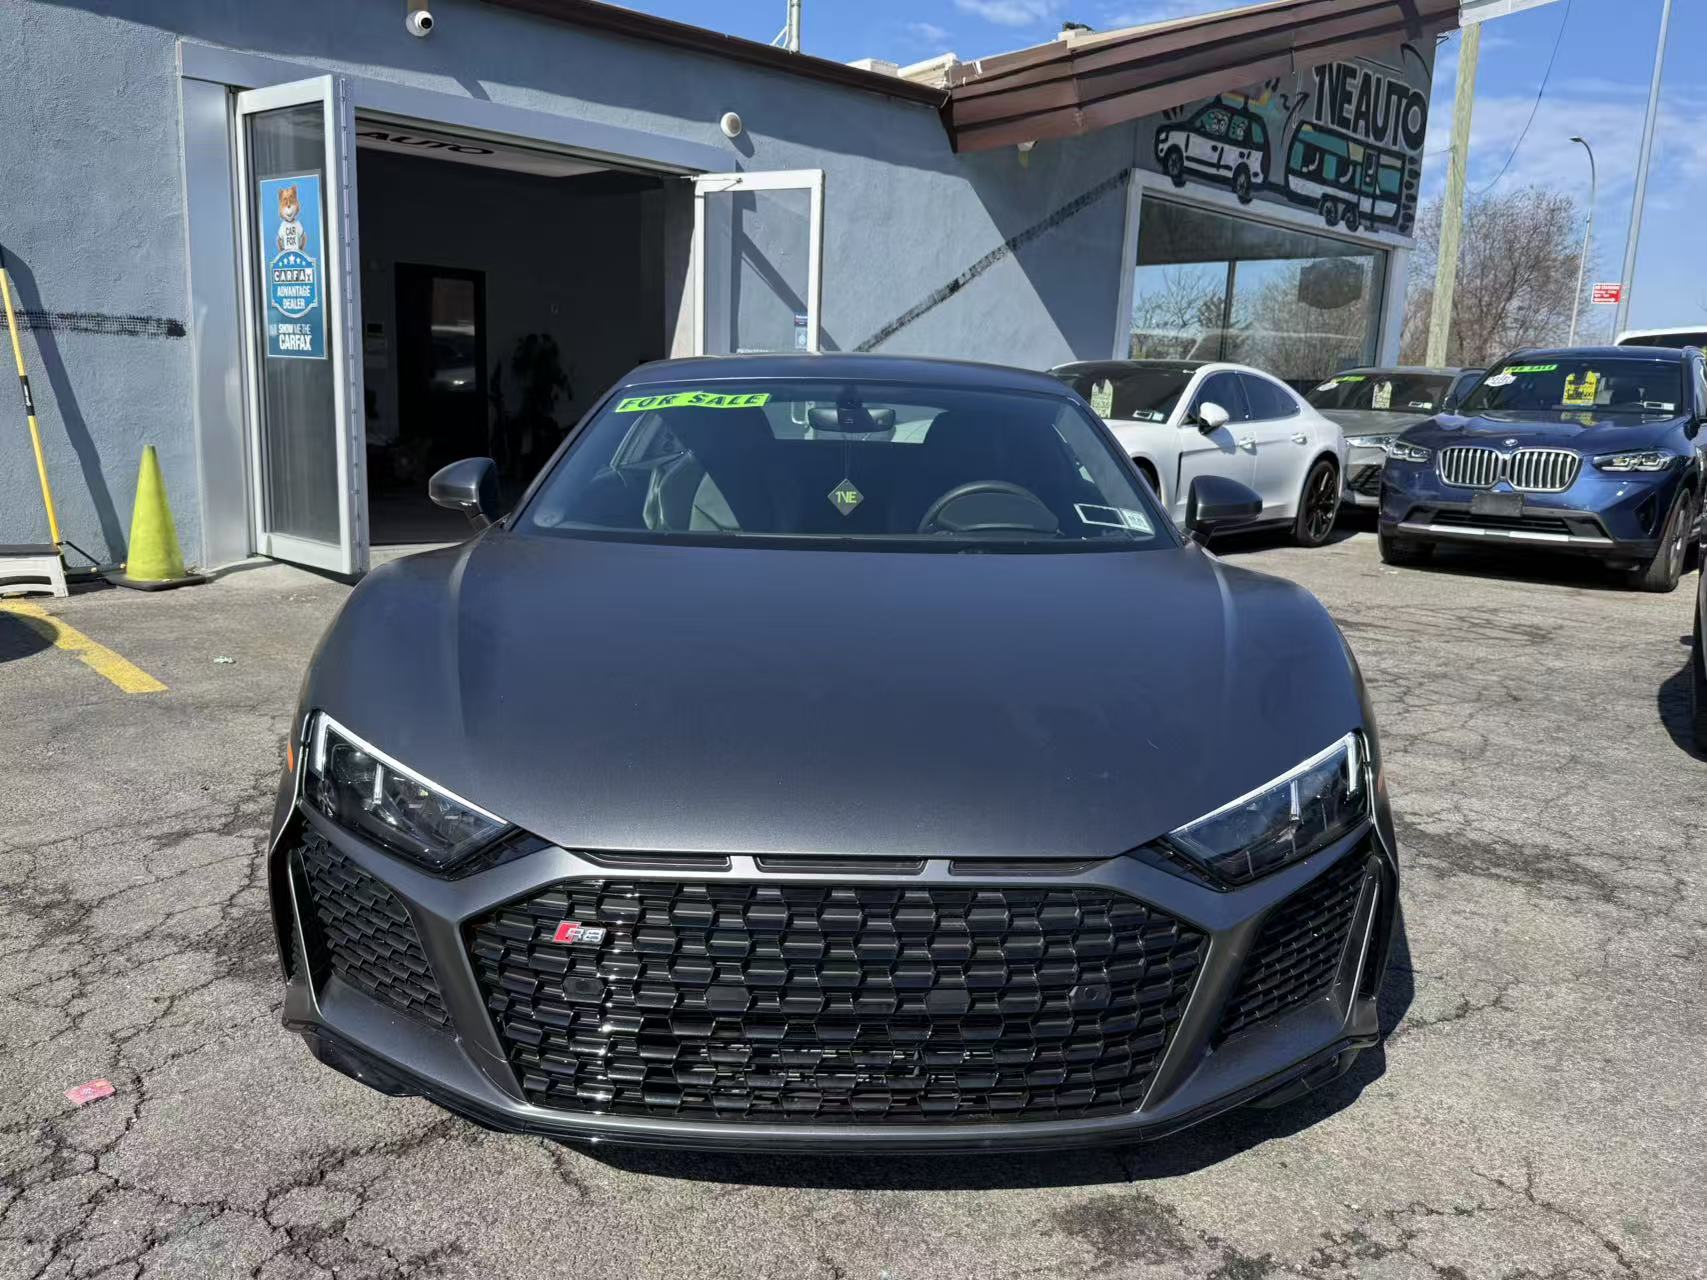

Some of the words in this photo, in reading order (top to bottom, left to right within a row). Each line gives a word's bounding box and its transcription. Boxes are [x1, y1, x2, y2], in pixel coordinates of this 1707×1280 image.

[285, 227, 296, 235] CAR
[286, 237, 297, 246] FOX
[274, 269, 313, 283] CARFAX
[277, 285, 311, 298] ADVANTAGE
[282, 298, 305, 309] DEALER
[278, 323, 293, 334] SHOW
[279, 334, 312, 351] CARFAX
[619, 395, 678, 411] FOR
[687, 393, 762, 406] SALE
